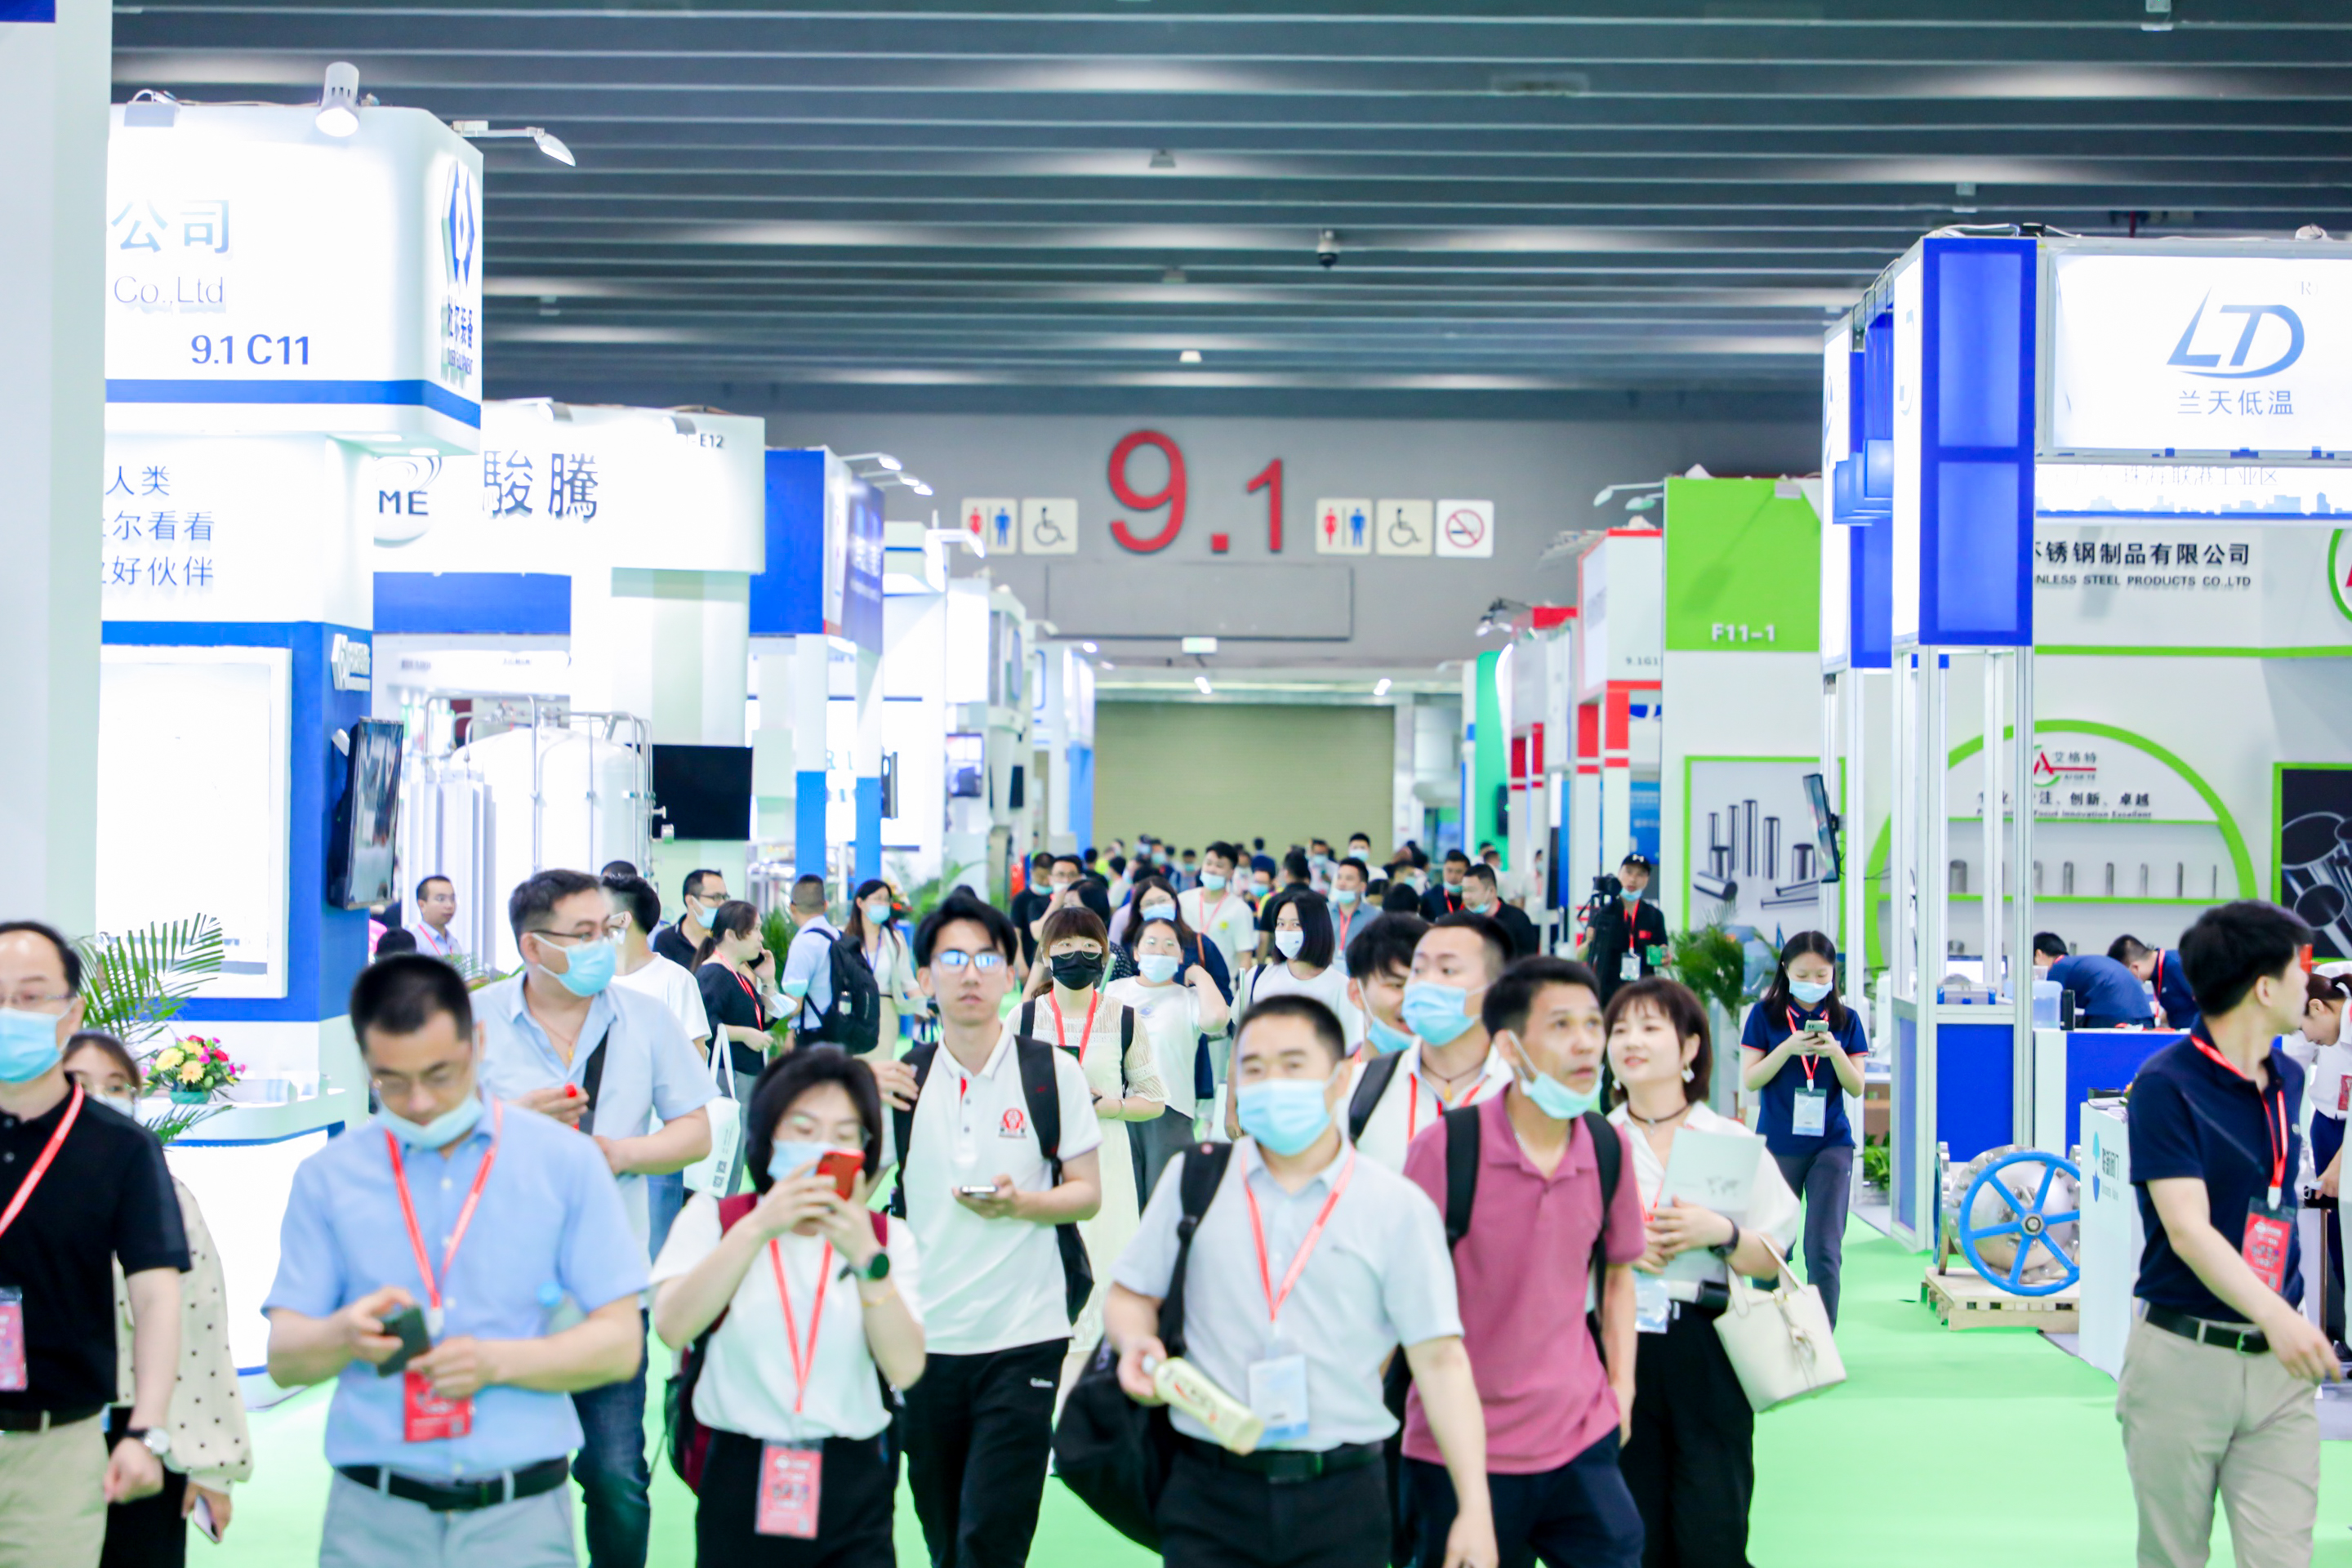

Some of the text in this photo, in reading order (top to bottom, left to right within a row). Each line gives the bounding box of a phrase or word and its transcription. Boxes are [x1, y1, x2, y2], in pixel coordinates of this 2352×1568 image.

[111, 198, 229, 253] 公司
[114, 275, 223, 305] Co.,Ltd
[191, 333, 309, 365] 9.1 C11
[2177, 390, 2294, 416] 兰天低温
[105, 466, 171, 496] 人类
[482, 450, 599, 519] 駿騰
[1108, 429, 1282, 553] 9.1
[103, 510, 215, 541] 尔看看
[102, 555, 214, 587] 好伙伴
[2083, 574, 2122, 586] STEEL
[2127, 575, 2196, 586] PRODUCTS
[1712, 623, 1775, 642] F11-1
